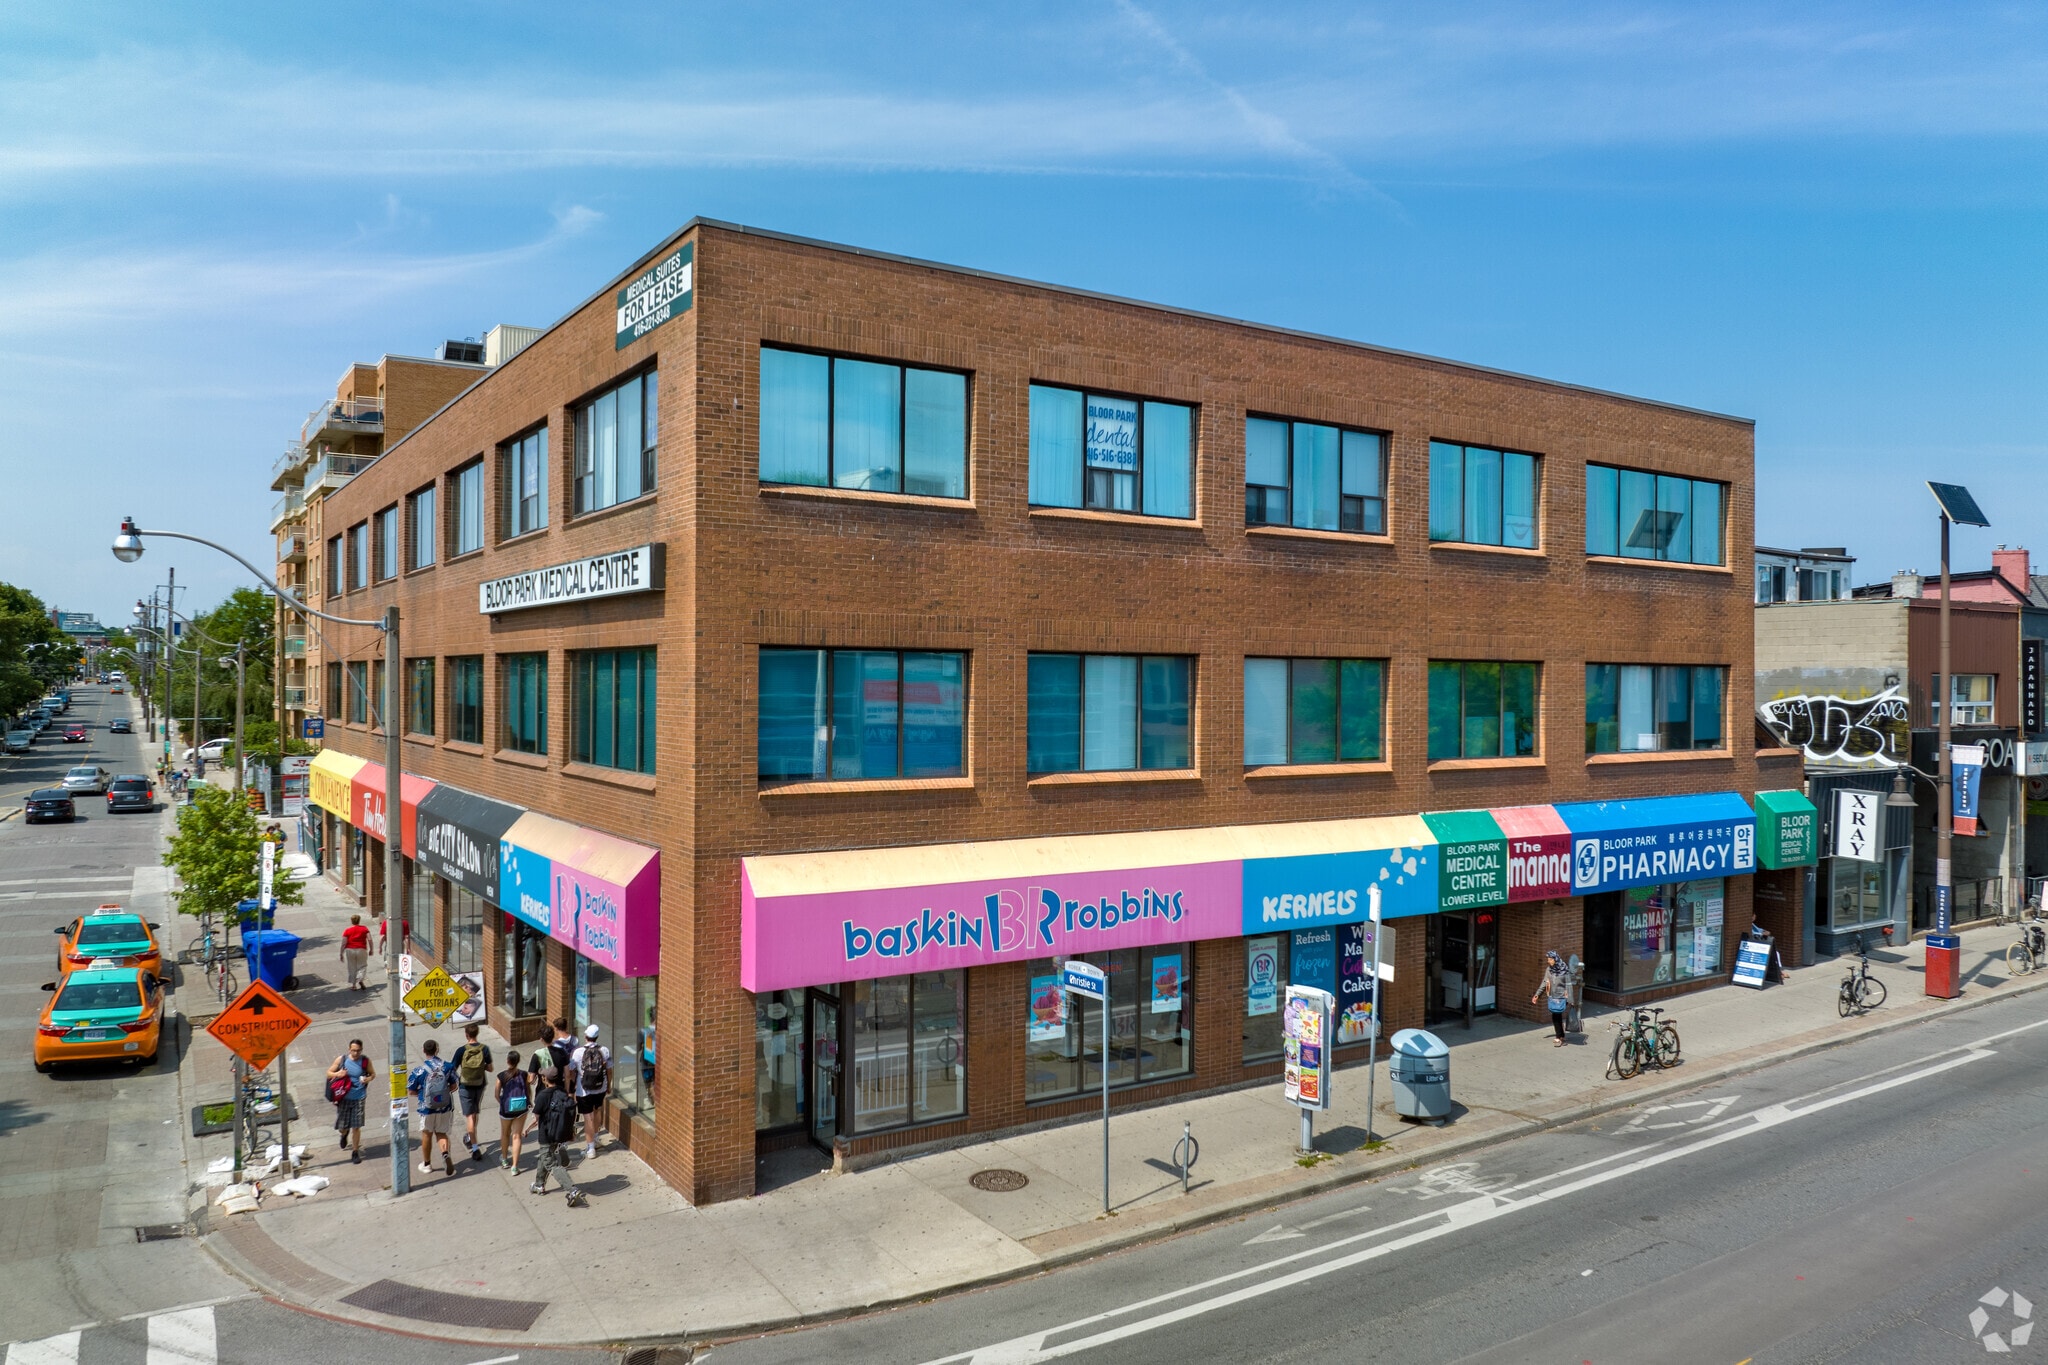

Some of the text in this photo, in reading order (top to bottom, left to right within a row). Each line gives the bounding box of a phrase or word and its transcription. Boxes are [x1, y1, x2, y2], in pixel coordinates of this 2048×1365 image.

[626, 252, 681, 302] MEDICAL SUITES
[624, 270, 684, 327] FOR LEASE
[1088, 405, 1137, 424] BLOOR PARK
[1087, 422, 1137, 449] dental
[486, 551, 639, 608] BLOOR PARK MEDICAL CENTRE
[1781, 815, 1811, 828] BLOOR
[1851, 794, 1867, 857] XRAY
[1603, 835, 1657, 851] BLOOR PARK
[1781, 828, 1804, 839] PARK
[428, 825, 439, 853] BIG
[440, 823, 456, 862] CITY
[457, 829, 481, 875] SALON
[1447, 843, 1500, 856] BLOOR PARK
[1513, 841, 1542, 853] The
[1737, 828, 1751, 866] 약국
[1781, 840, 1803, 848] MEDICAL
[1781, 847, 1801, 855] CENTRE
[1446, 854, 1500, 874] MEDICAL
[1509, 853, 1571, 888] manna
[1602, 843, 1731, 883] PHARMACY
[1451, 872, 1496, 891] CENTRE
[584, 885, 618, 927] baskin
[1262, 889, 1358, 923] KERNELS
[1442, 893, 1475, 907] LOWER
[1477, 890, 1505, 903] LEVEL
[520, 892, 550, 927] KERNELS
[1623, 908, 1674, 931] PHARMACY
[842, 886, 1183, 961] baskin BR robbins
[584, 921, 618, 961] robbins
[1295, 930, 1331, 946] Refresh
[1295, 954, 1331, 977] frozen
[424, 978, 450, 988] WATCH
[1069, 974, 1097, 990] Christie St
[429, 988, 444, 998] FOR
[413, 998, 460, 1009] PEDESTRIANS
[217, 1018, 300, 1036] CONSTRUCTION
